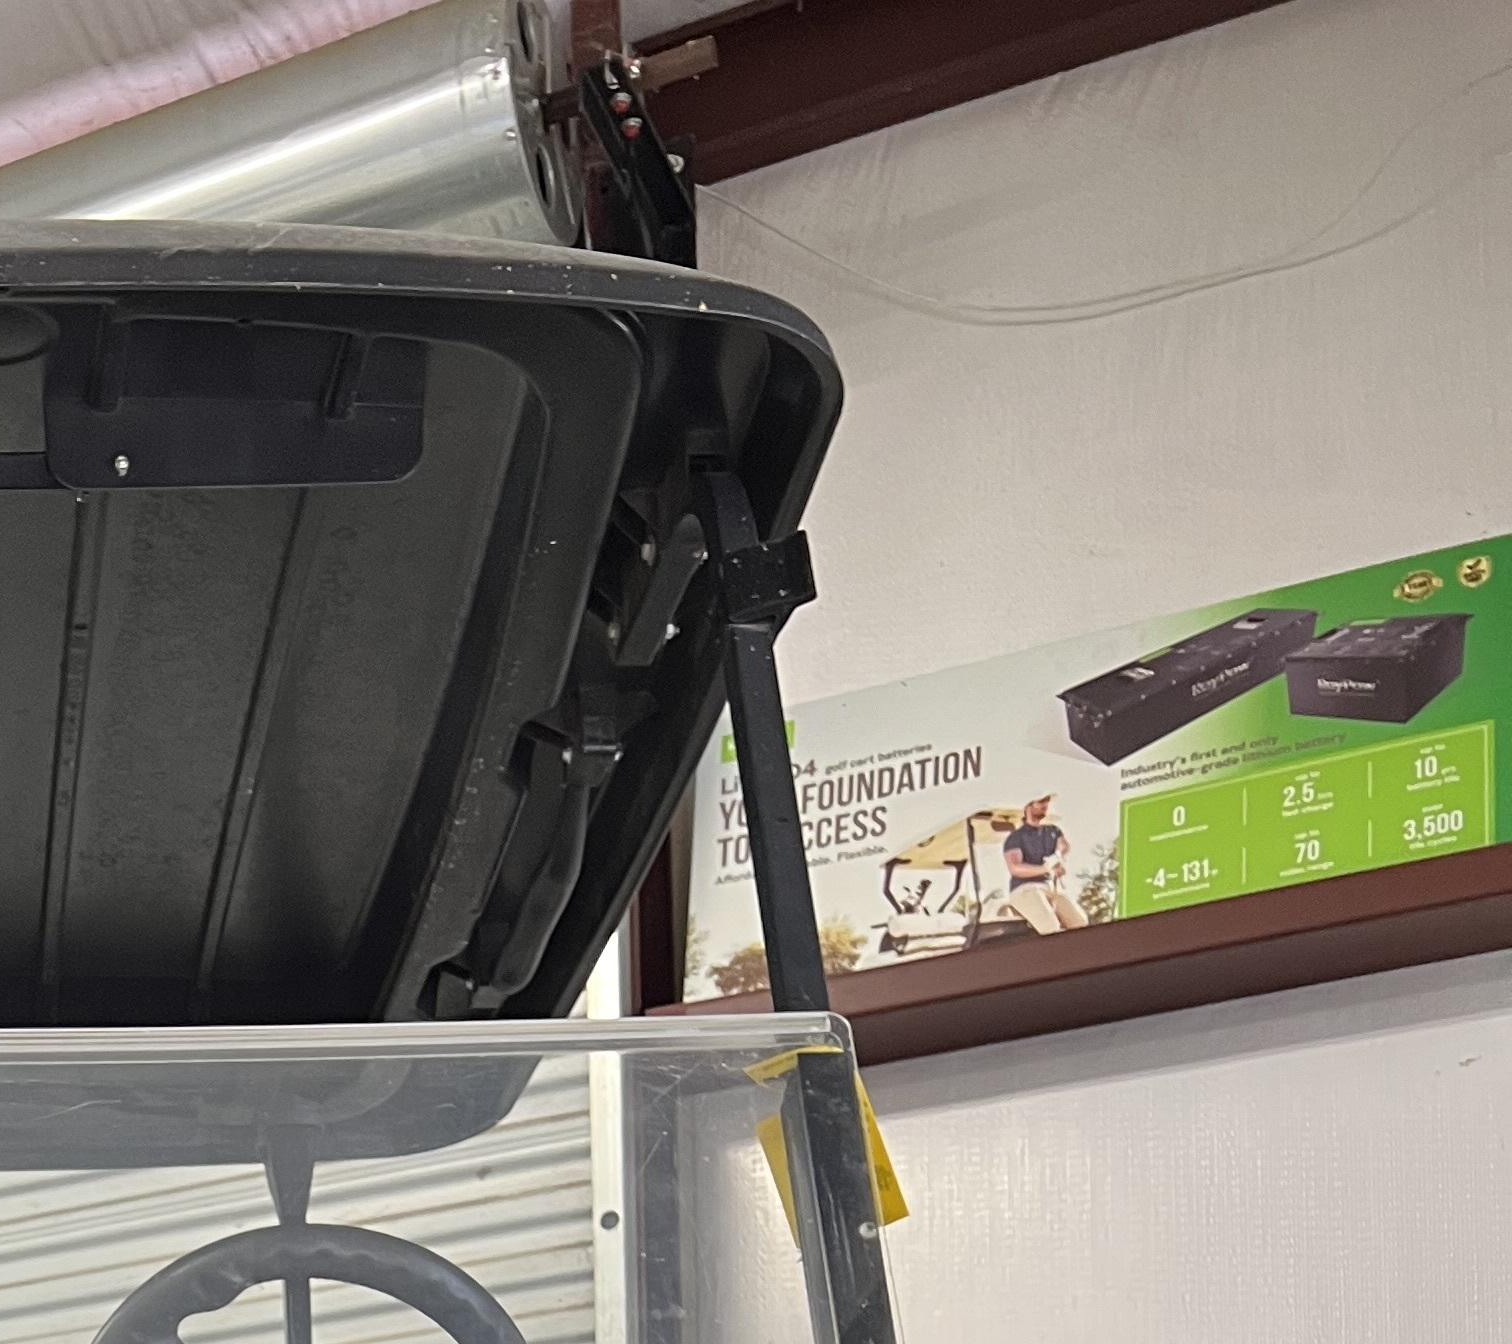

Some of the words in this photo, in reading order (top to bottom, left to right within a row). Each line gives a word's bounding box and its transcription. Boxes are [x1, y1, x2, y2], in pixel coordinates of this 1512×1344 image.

[1414, 755, 1438, 779] 10
[801, 745, 983, 815] FOUNDATION
[1283, 782, 1315, 807] 2.5
[1172, 804, 1187, 827] 0
[1403, 809, 1464, 841] 3,500
[717, 833, 750, 868] TO
[800, 805, 888, 851] CCESS
[1294, 839, 1320, 864] 70
